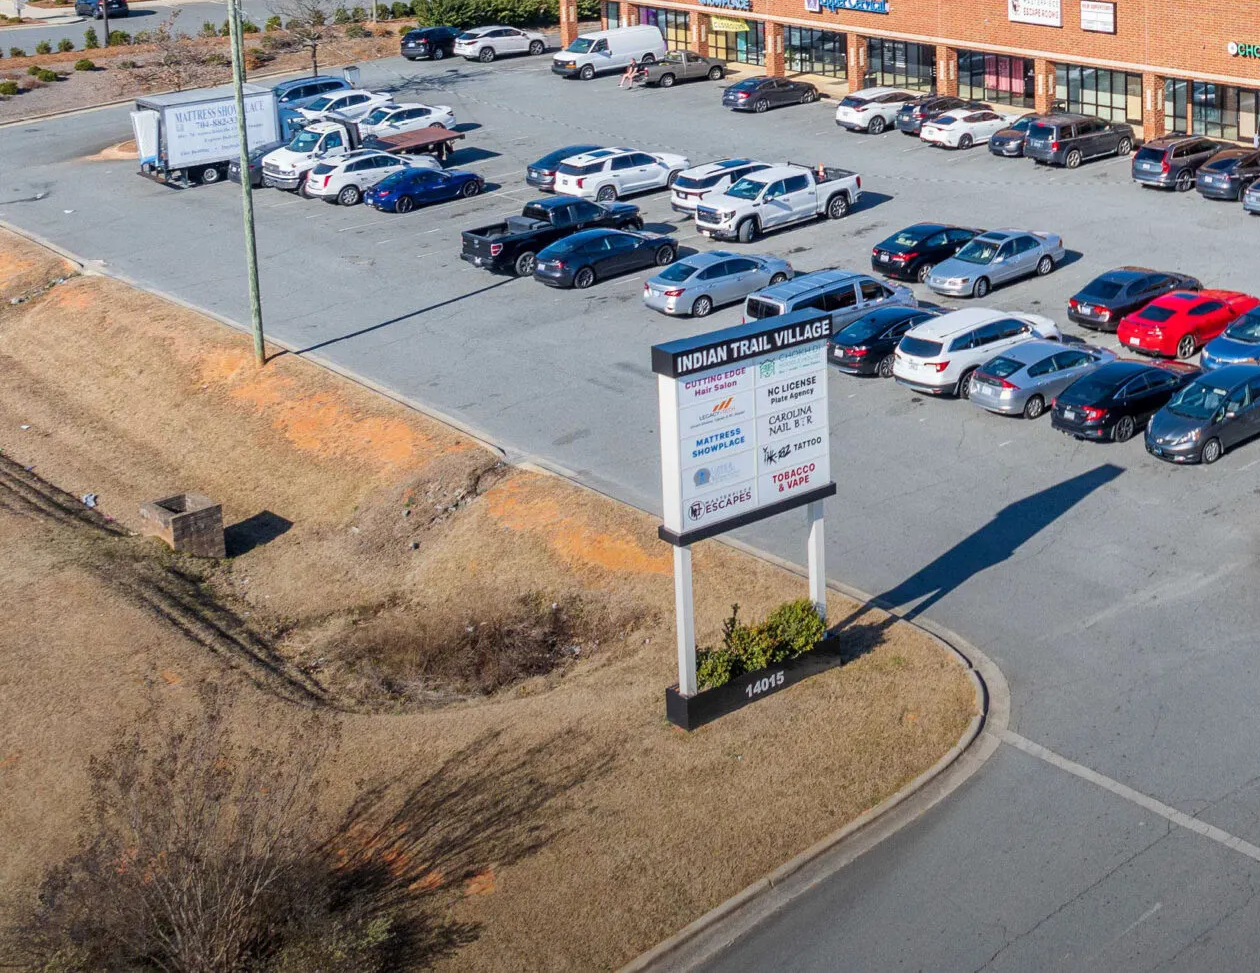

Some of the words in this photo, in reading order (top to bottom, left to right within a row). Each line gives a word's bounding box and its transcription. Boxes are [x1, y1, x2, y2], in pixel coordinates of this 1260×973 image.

[175, 107, 217, 123] MATTRESS
[677, 346, 728, 373] INDIAN
[730, 334, 771, 359] TRAIL
[774, 319, 830, 346] VILLAGE
[685, 373, 723, 390] CUTTING
[724, 366, 746, 380] EDGE
[767, 386, 780, 397] NC
[782, 375, 817, 393] LICENSE
[694, 386, 712, 397] Hair
[714, 380, 738, 392] Salon
[770, 395, 788, 405] Plate
[789, 388, 814, 400] Agency
[768, 405, 812, 425] CAROLINA
[696, 427, 742, 447] MATTRESS
[769, 422, 791, 436] NAIL
[692, 435, 746, 458] SHOWPLACE
[794, 436, 822, 452] TATTOO
[772, 462, 816, 484] TOBACCO
[778, 483, 784, 493] &
[786, 474, 809, 489] VAPE
[705, 491, 752, 514] ESCAPES
[746, 670, 785, 699] 14015
